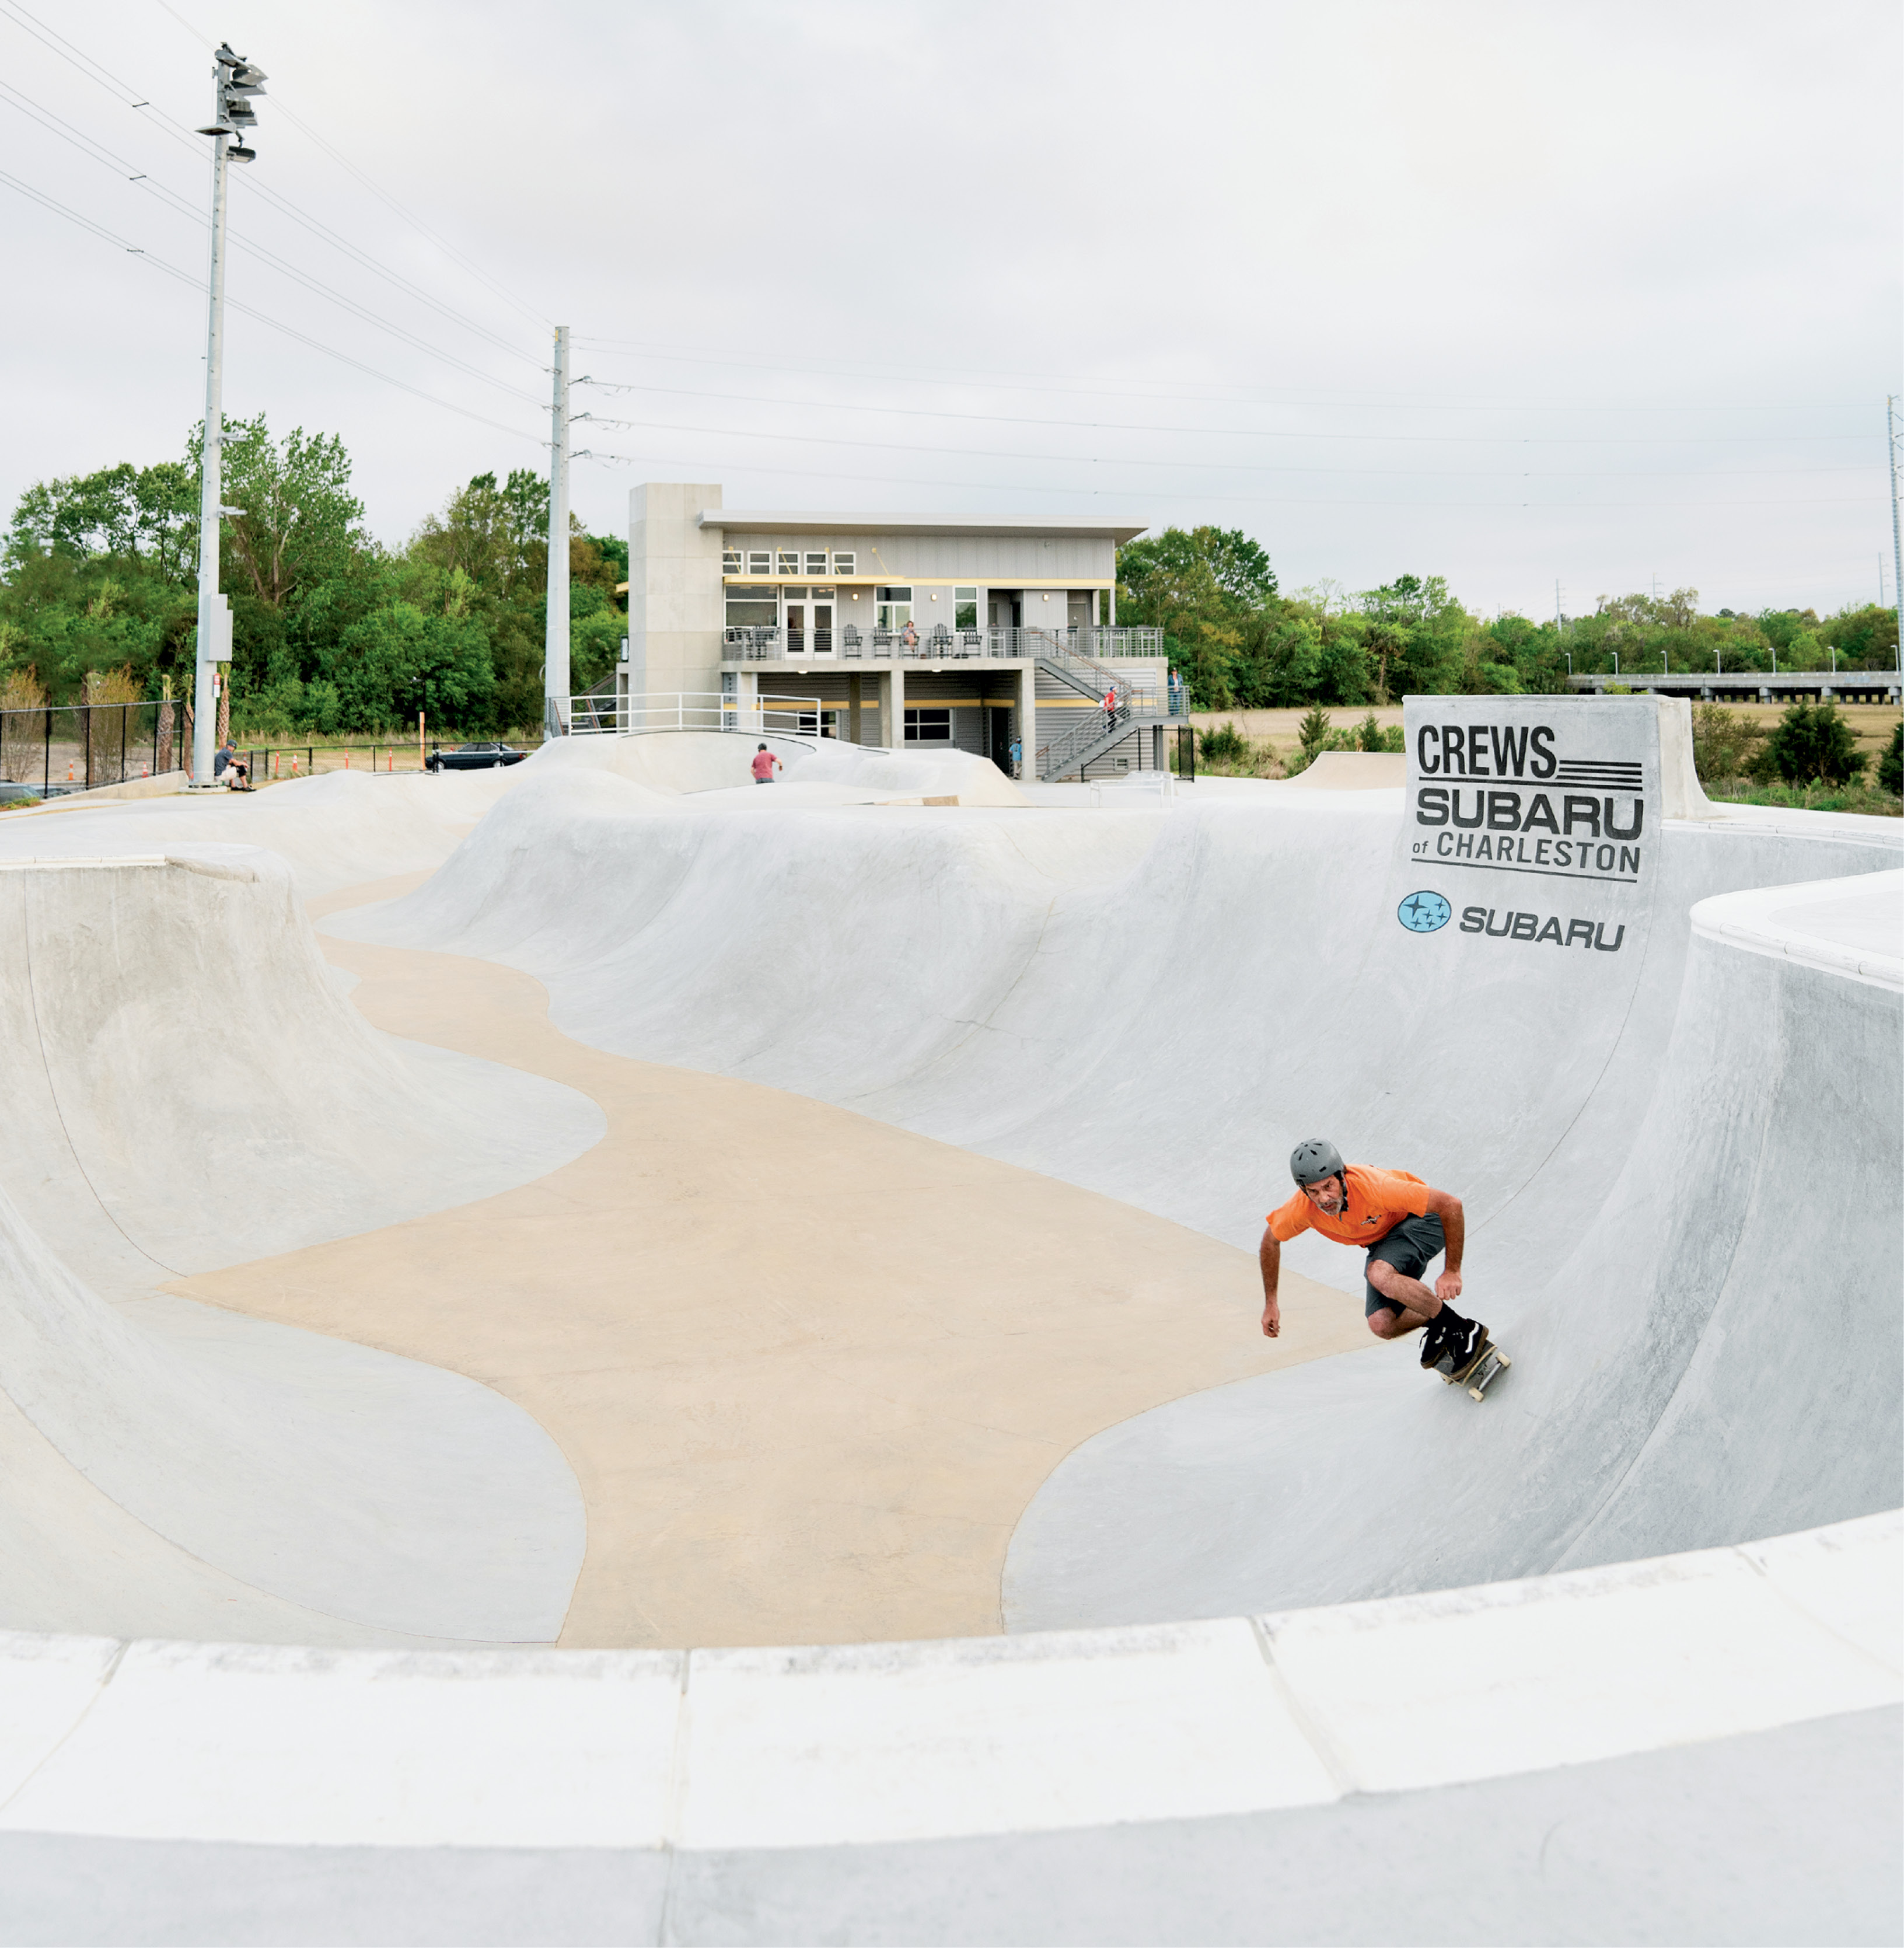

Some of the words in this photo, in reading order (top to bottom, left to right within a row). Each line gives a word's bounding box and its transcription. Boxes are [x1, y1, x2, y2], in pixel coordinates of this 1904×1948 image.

[1417, 724, 1557, 779] CREWS
[1417, 787, 1644, 840] SUBARU
[1412, 841, 1428, 854] of
[1437, 831, 1641, 874] CHARLESTON
[1459, 906, 1626, 952] SUBARU
